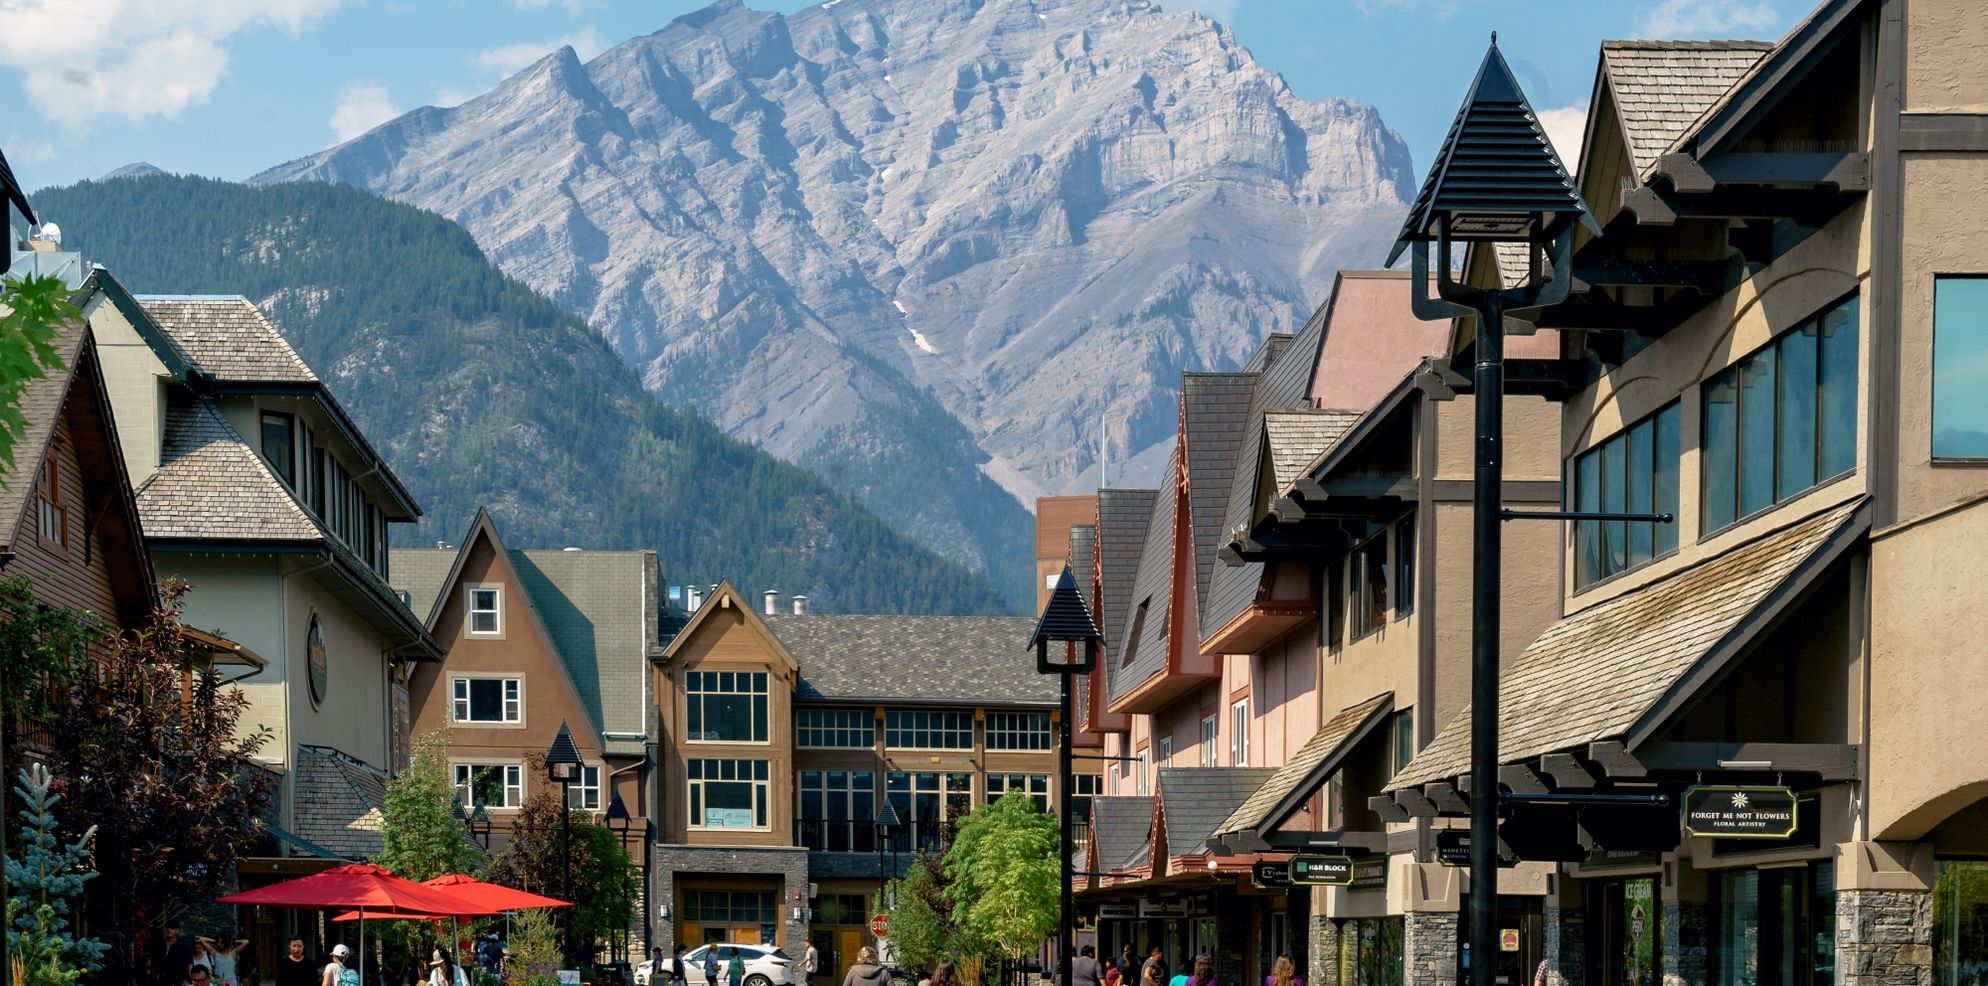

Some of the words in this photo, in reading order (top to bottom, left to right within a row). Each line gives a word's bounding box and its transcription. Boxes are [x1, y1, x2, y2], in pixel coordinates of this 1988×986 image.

[1736, 812, 1752, 820] NOT
[1755, 812, 1790, 820] FLOWERS
[1625, 883, 1634, 899] ICE
[1634, 883, 1652, 899] CREAM
[872, 920, 887, 930] STO
